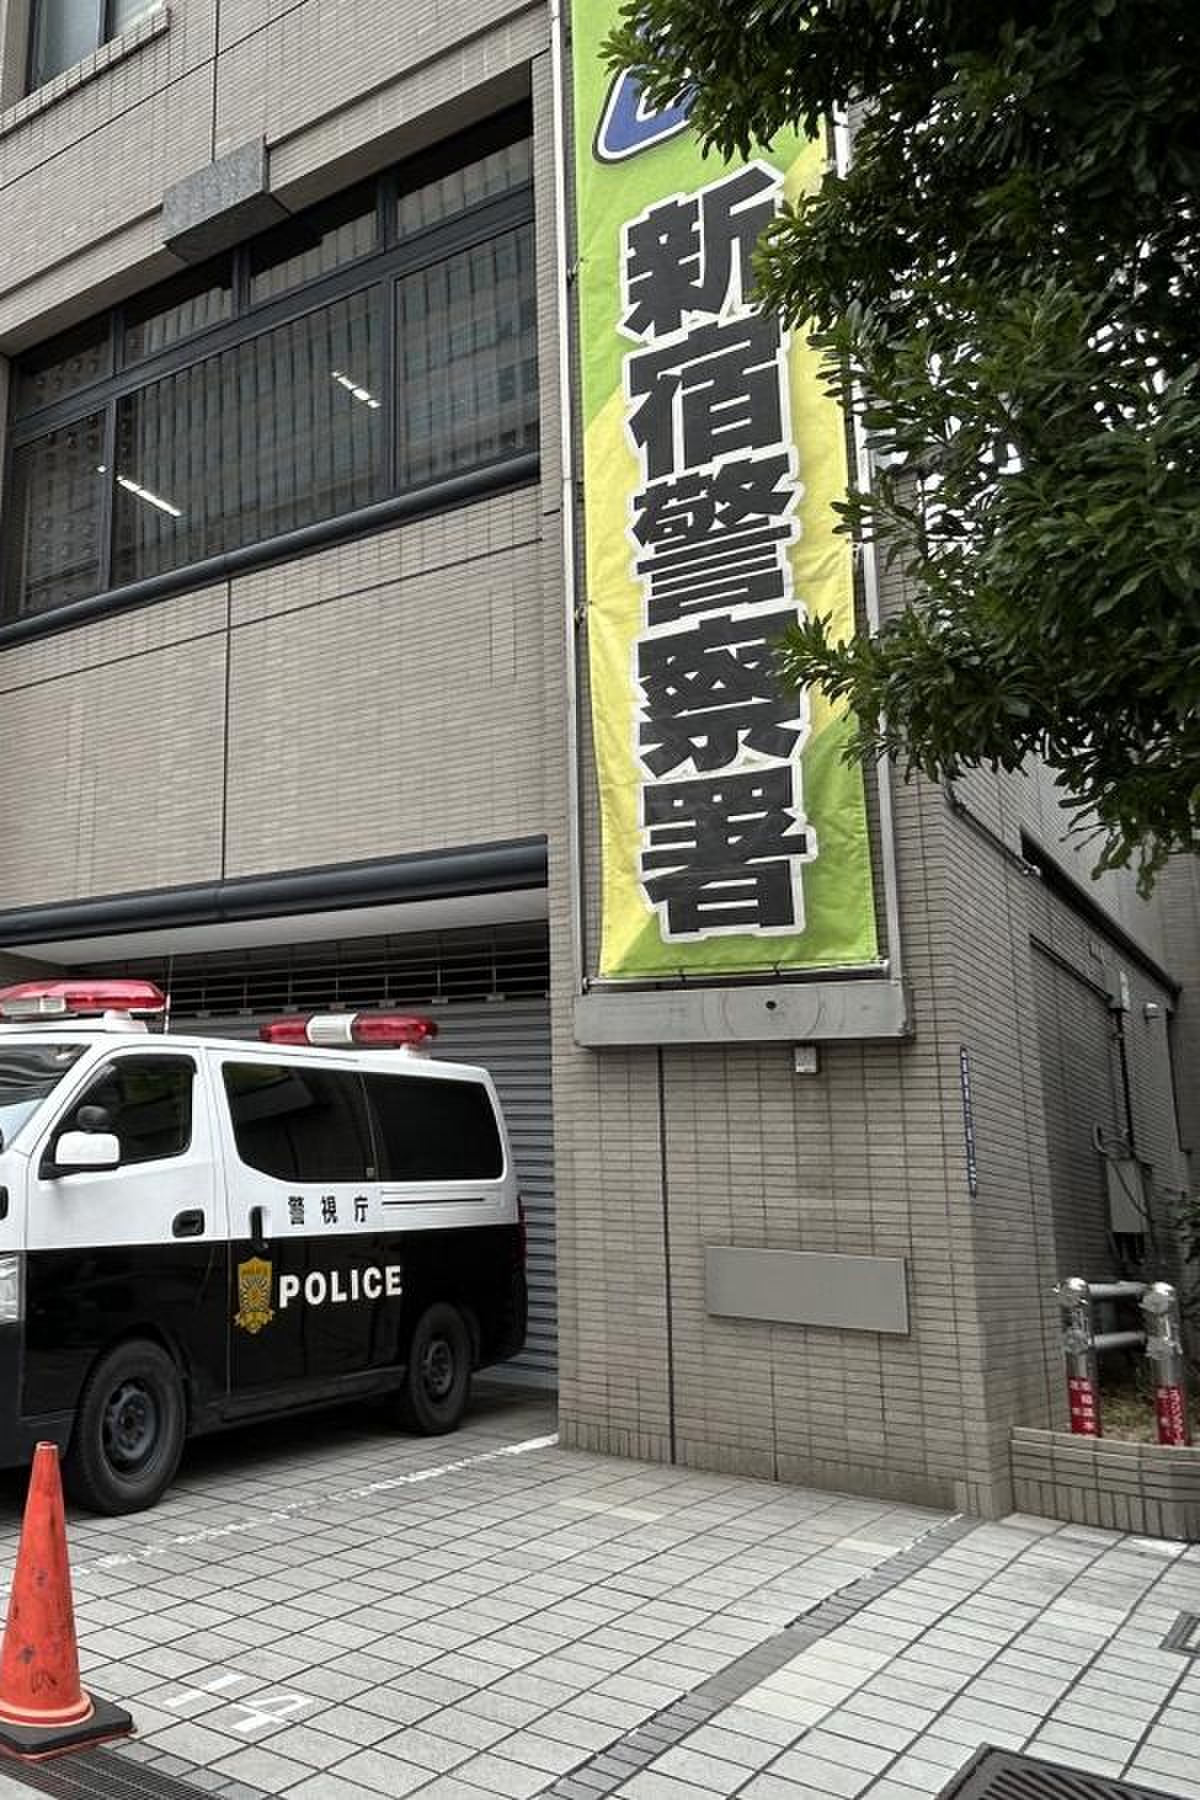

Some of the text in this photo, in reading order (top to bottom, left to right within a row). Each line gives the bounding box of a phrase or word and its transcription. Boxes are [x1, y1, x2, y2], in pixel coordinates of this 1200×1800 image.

[619, 161, 812, 939] 新宿警察署
[287, 1195, 369, 1226] 警視庁
[278, 1264, 402, 1309] POLICE
